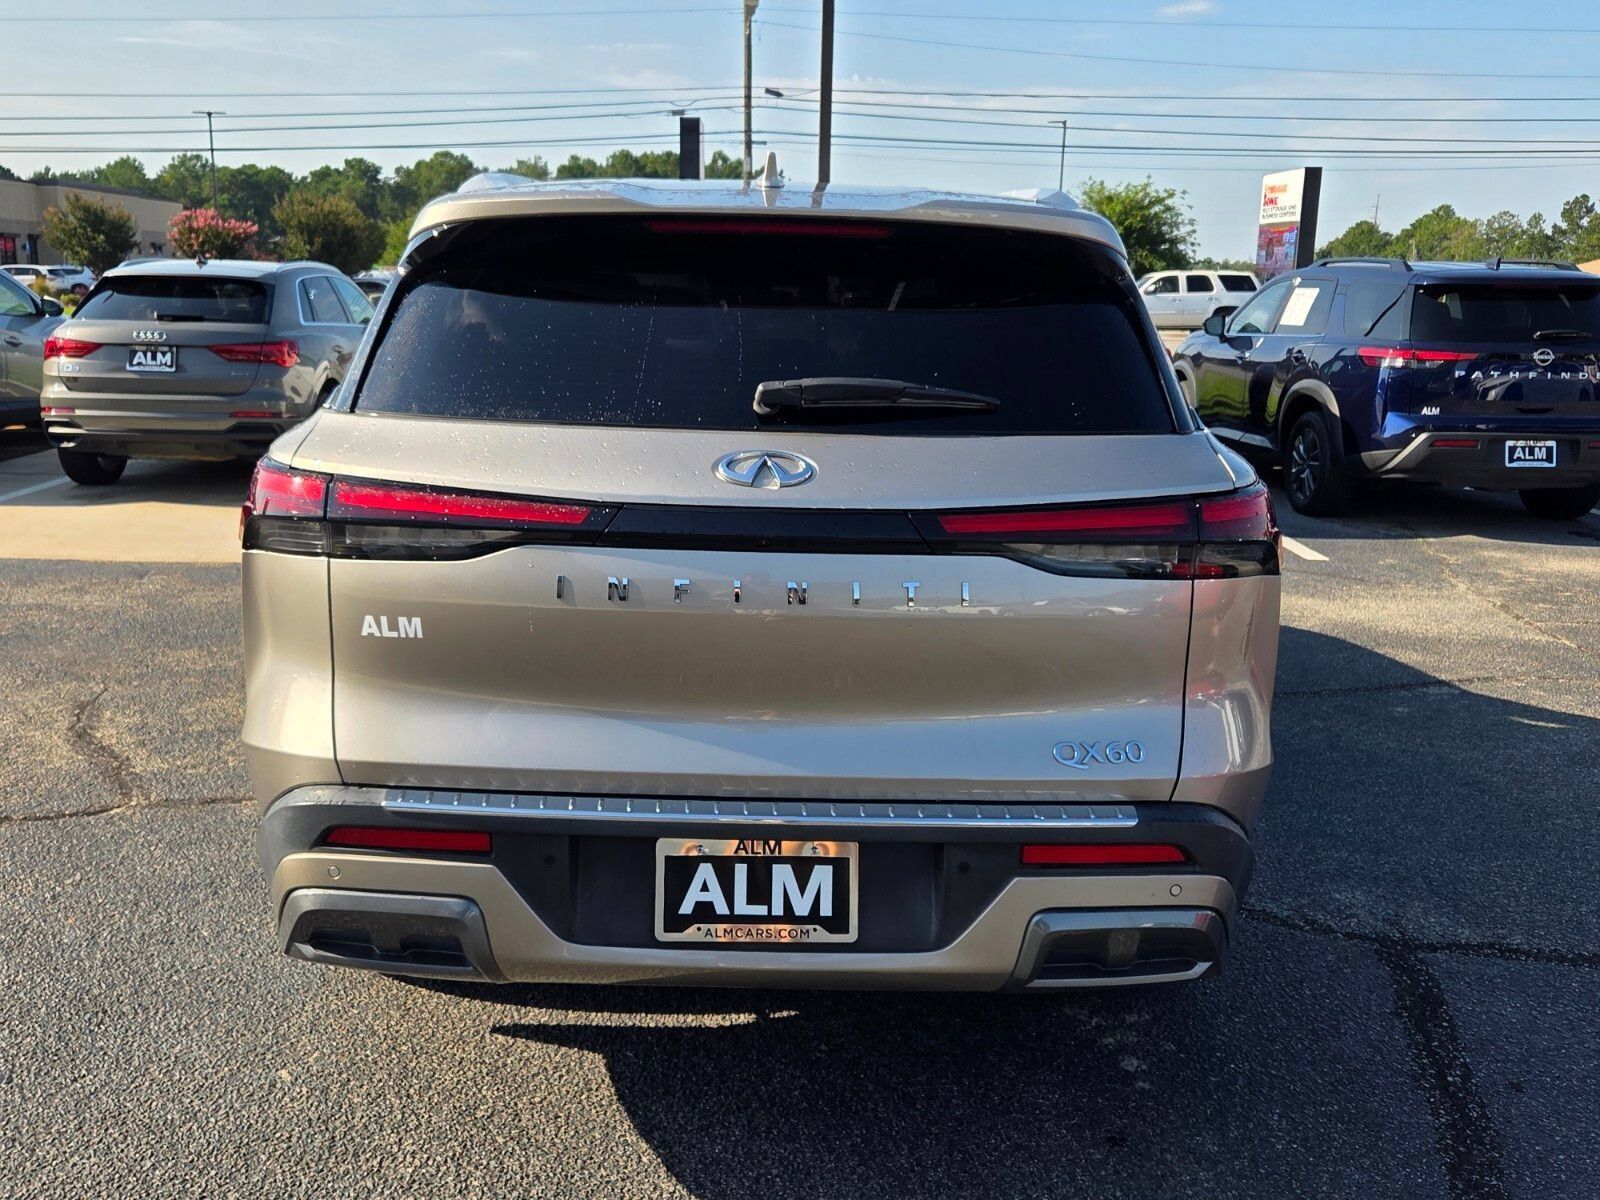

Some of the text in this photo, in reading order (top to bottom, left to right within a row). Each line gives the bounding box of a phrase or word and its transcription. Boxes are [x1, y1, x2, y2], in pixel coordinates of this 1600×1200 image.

[132, 351, 172, 366] ALM
[1421, 406, 1440, 415] ALM
[1513, 447, 1547, 460] ALM
[556, 575, 970, 607] INFINITI
[361, 615, 423, 638] ALM
[1052, 740, 1146, 770] QX60
[733, 839, 782, 856] ALM
[678, 862, 834, 917] ALM
[703, 927, 810, 940] ALMCARS.COM
